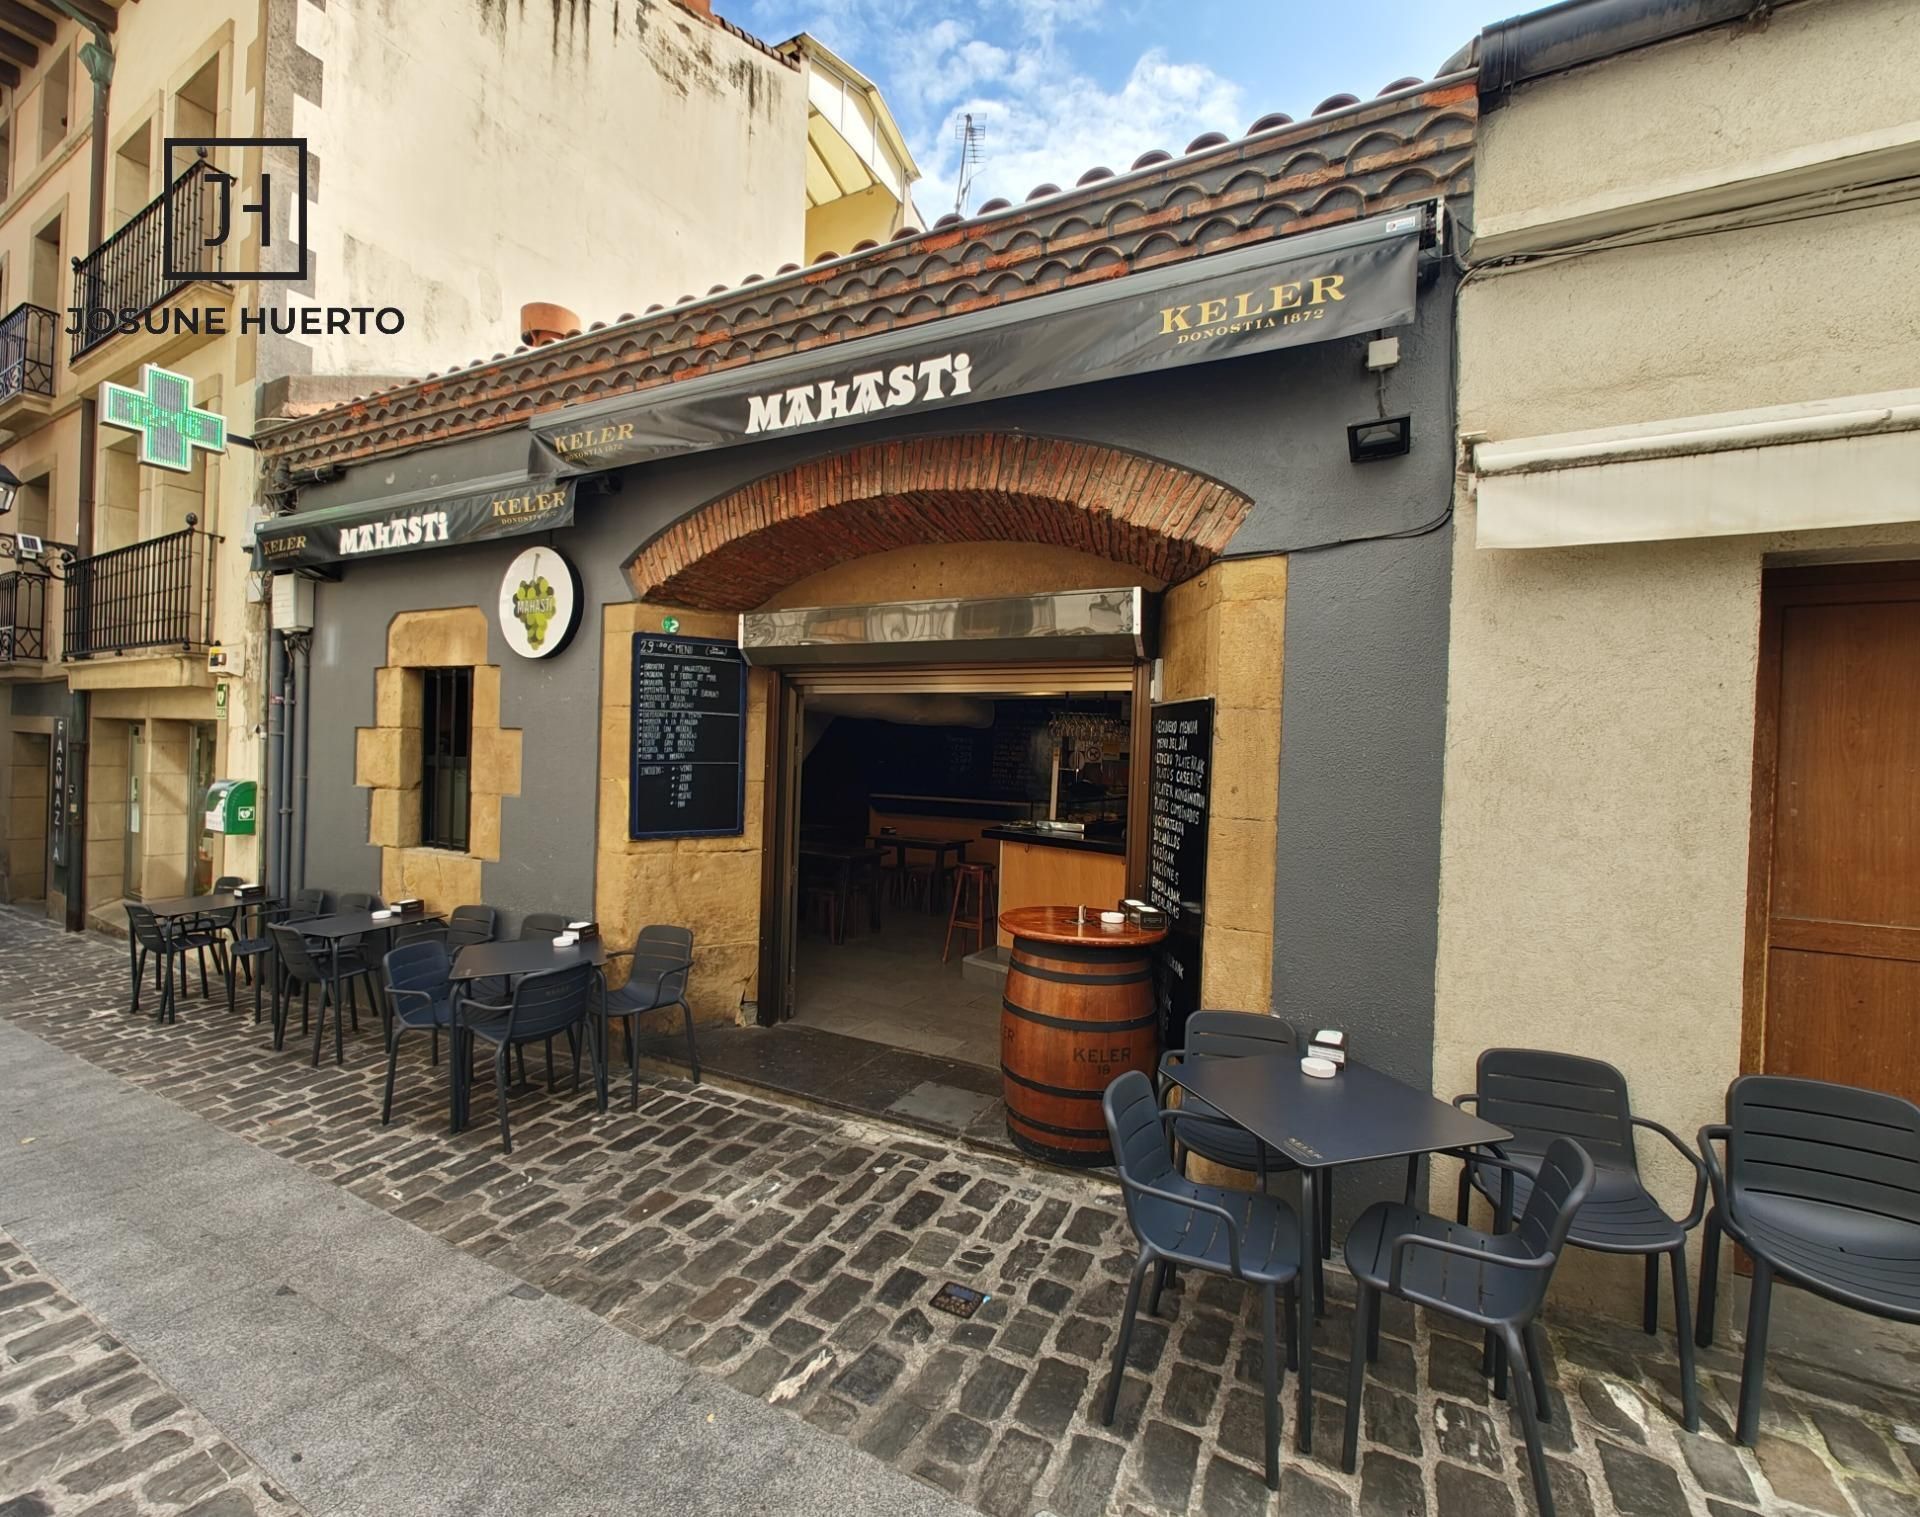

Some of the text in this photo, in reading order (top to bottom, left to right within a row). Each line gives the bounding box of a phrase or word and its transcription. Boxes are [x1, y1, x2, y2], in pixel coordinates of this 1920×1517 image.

[1159, 275, 1345, 335] KELER
[1177, 310, 1325, 344] DONOSTIA 1872
[555, 424, 634, 453] KELER
[492, 490, 565, 517] KELER
[264, 536, 307, 556] KELER
[53, 720, 64, 861] FARMAZIA
[1073, 1047, 1132, 1064] KELER
